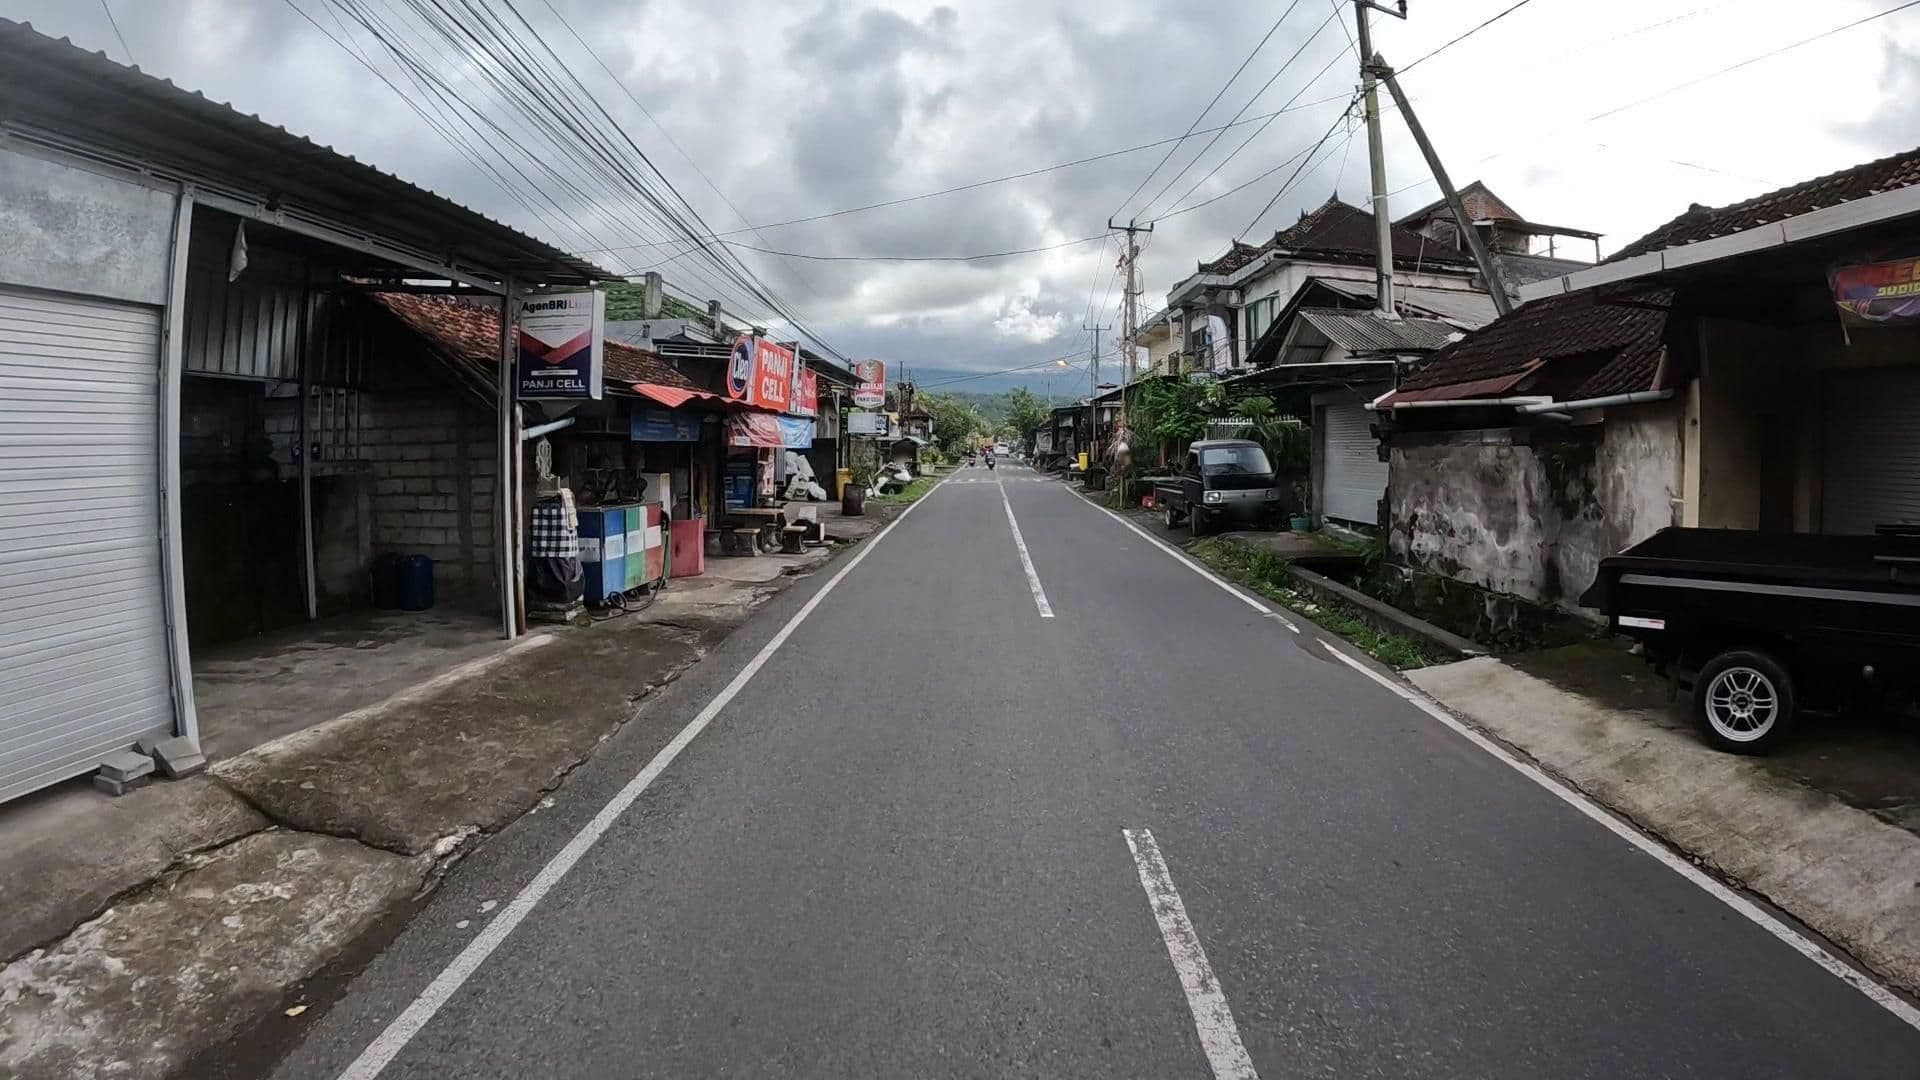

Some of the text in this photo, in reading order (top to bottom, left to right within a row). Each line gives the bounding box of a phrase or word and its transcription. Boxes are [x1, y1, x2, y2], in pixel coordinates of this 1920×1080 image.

[734, 351, 749, 380] Cleo
[762, 349, 787, 378] PANJI
[522, 378, 586, 389] PANJI CELL
[761, 376, 785, 403] CELL
